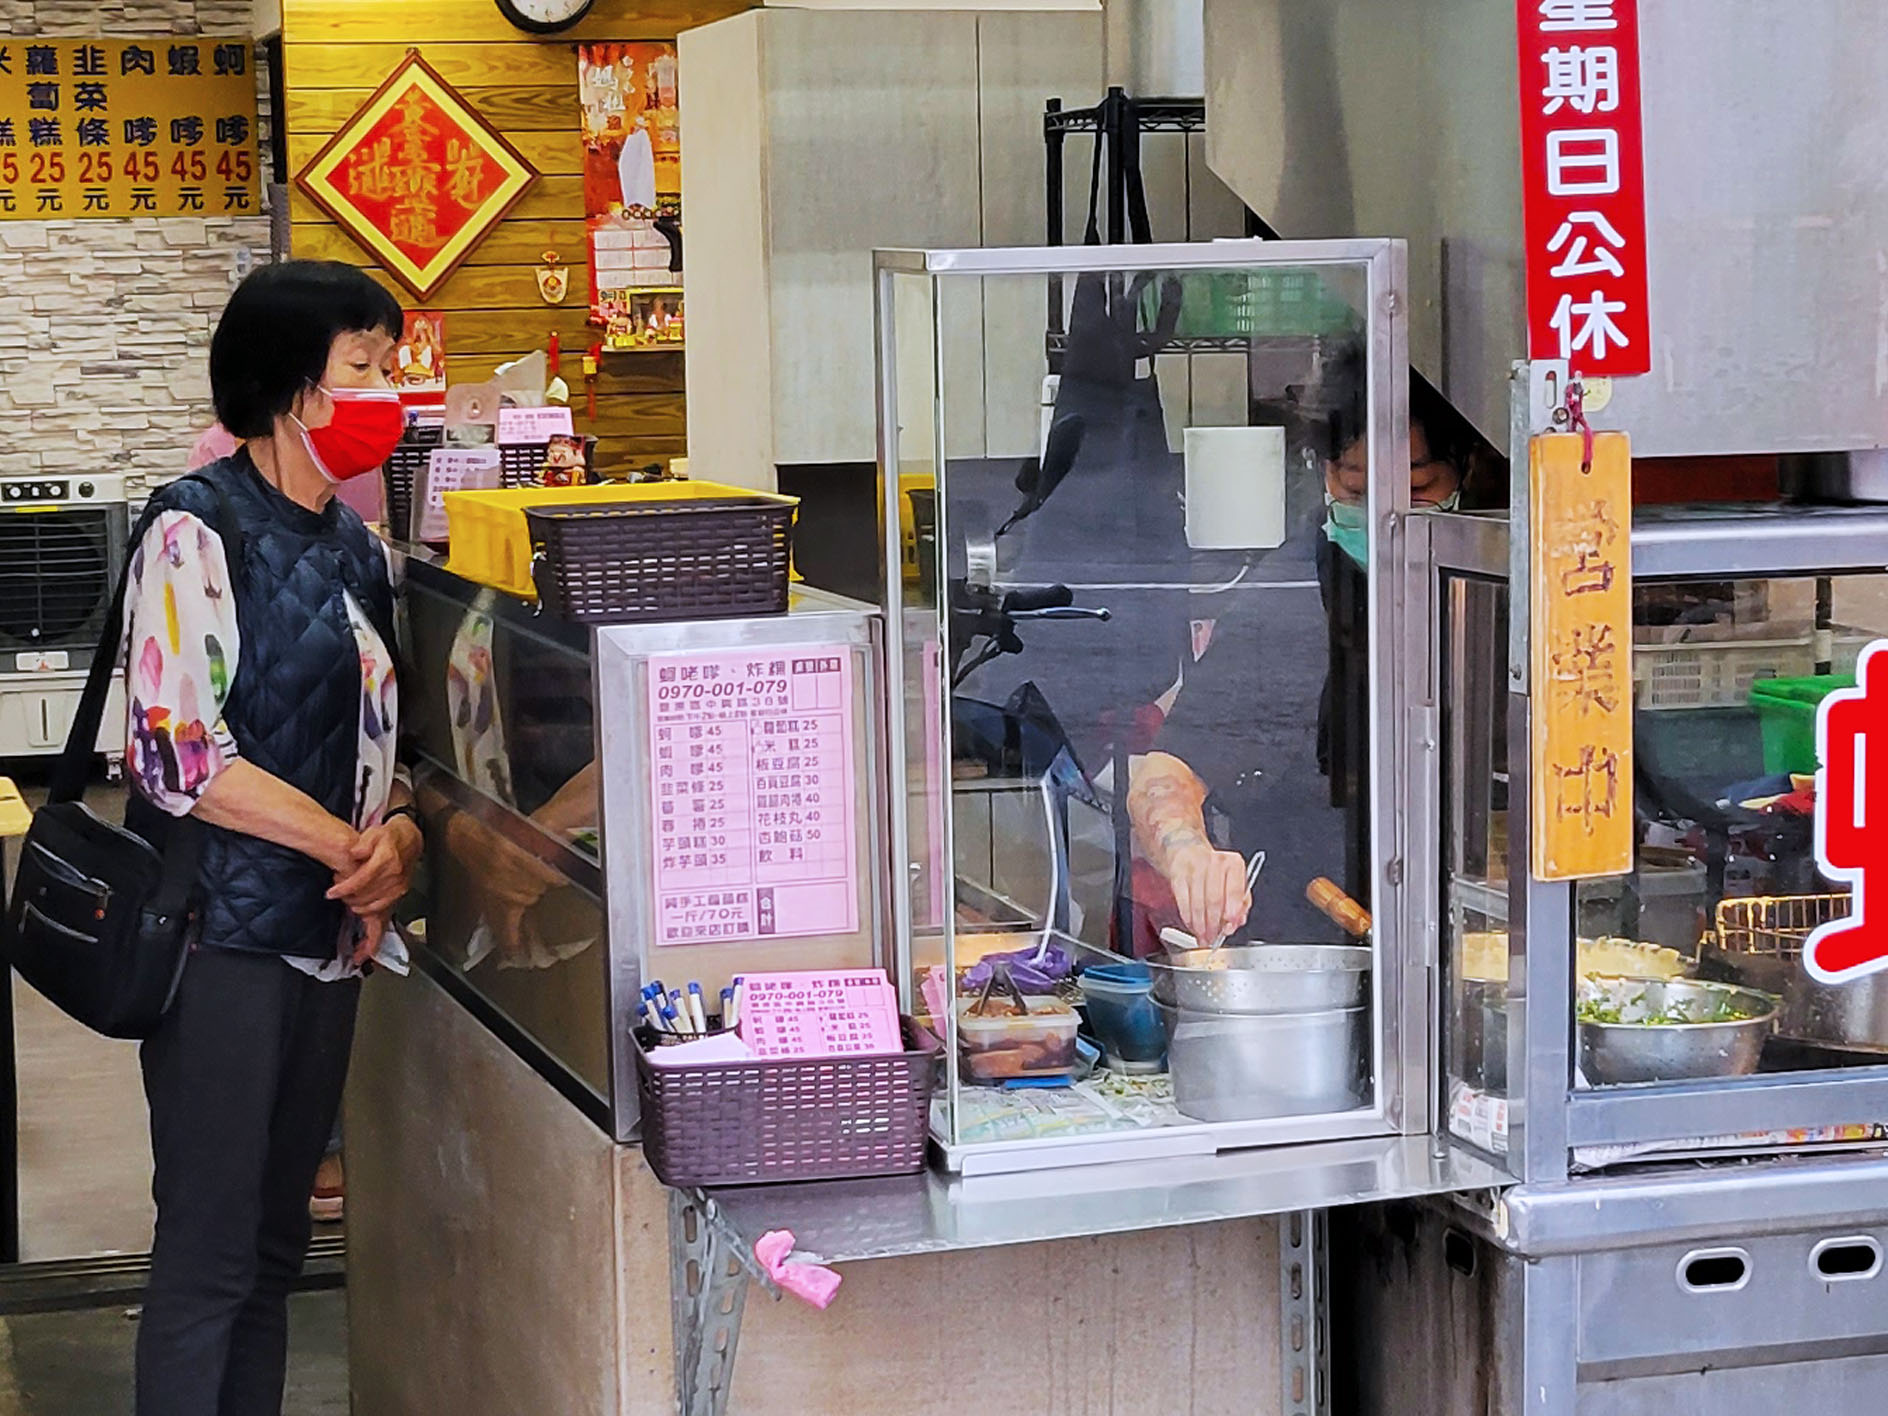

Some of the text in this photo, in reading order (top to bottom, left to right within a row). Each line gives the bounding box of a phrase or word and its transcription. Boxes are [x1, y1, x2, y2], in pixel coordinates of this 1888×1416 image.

[658, 680, 788, 700] 0970-001-079
[707, 725, 722, 736] 45
[803, 720, 819, 730] 25
[707, 743, 723, 755] 45
[804, 738, 819, 749] 25
[804, 756, 819, 767] 25
[707, 762, 724, 773] 45
[709, 780, 724, 791] 25
[805, 775, 819, 785] 30
[806, 793, 820, 804] 40
[710, 799, 725, 810] 25
[806, 811, 821, 822] 40
[710, 817, 725, 828] 25
[711, 835, 726, 846] 30
[806, 830, 821, 840] 50
[712, 853, 727, 864] 35
[749, 990, 844, 1001] 0970-001-079
